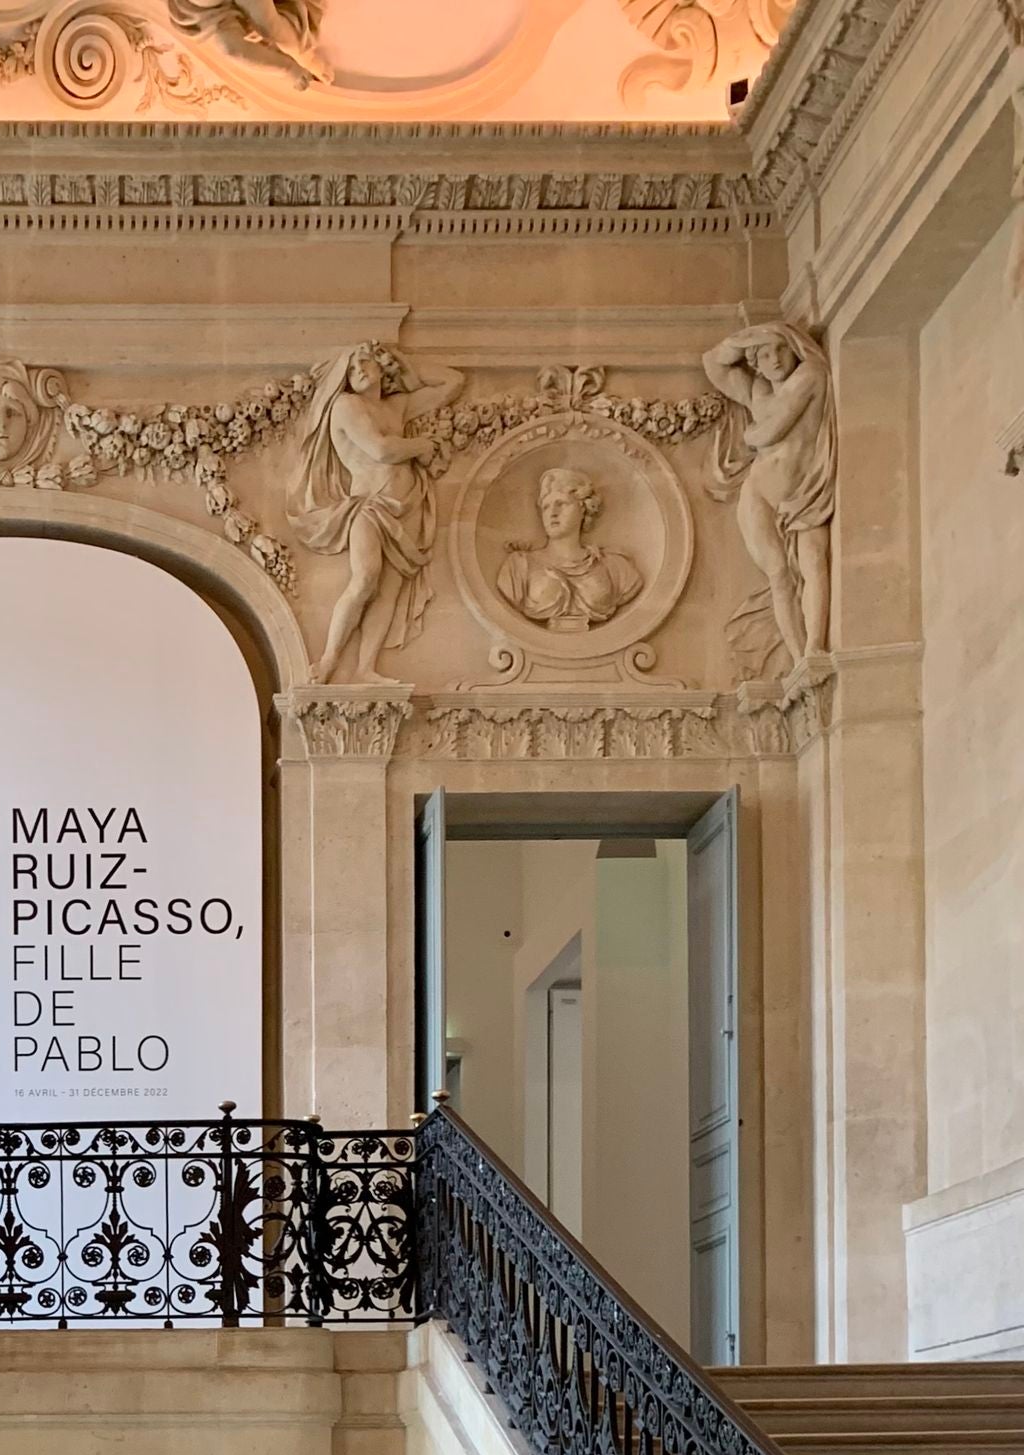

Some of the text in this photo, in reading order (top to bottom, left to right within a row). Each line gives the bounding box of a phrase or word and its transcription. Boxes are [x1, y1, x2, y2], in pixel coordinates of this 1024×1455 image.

[12, 807, 148, 844] MAYA
[12, 853, 148, 890] RUIZ-
[12, 898, 244, 940] PICASSO,
[13, 945, 143, 981] FILLE
[13, 990, 76, 1027] DE
[13, 1035, 170, 1073] PABLO
[14, 1088, 25, 1097] 16
[28, 1088, 58, 1097] AVRIL
[69, 1088, 79, 1097] 31
[83, 1086, 140, 1097] DÉCEMBRE
[143, 1087, 168, 1097] 2022
